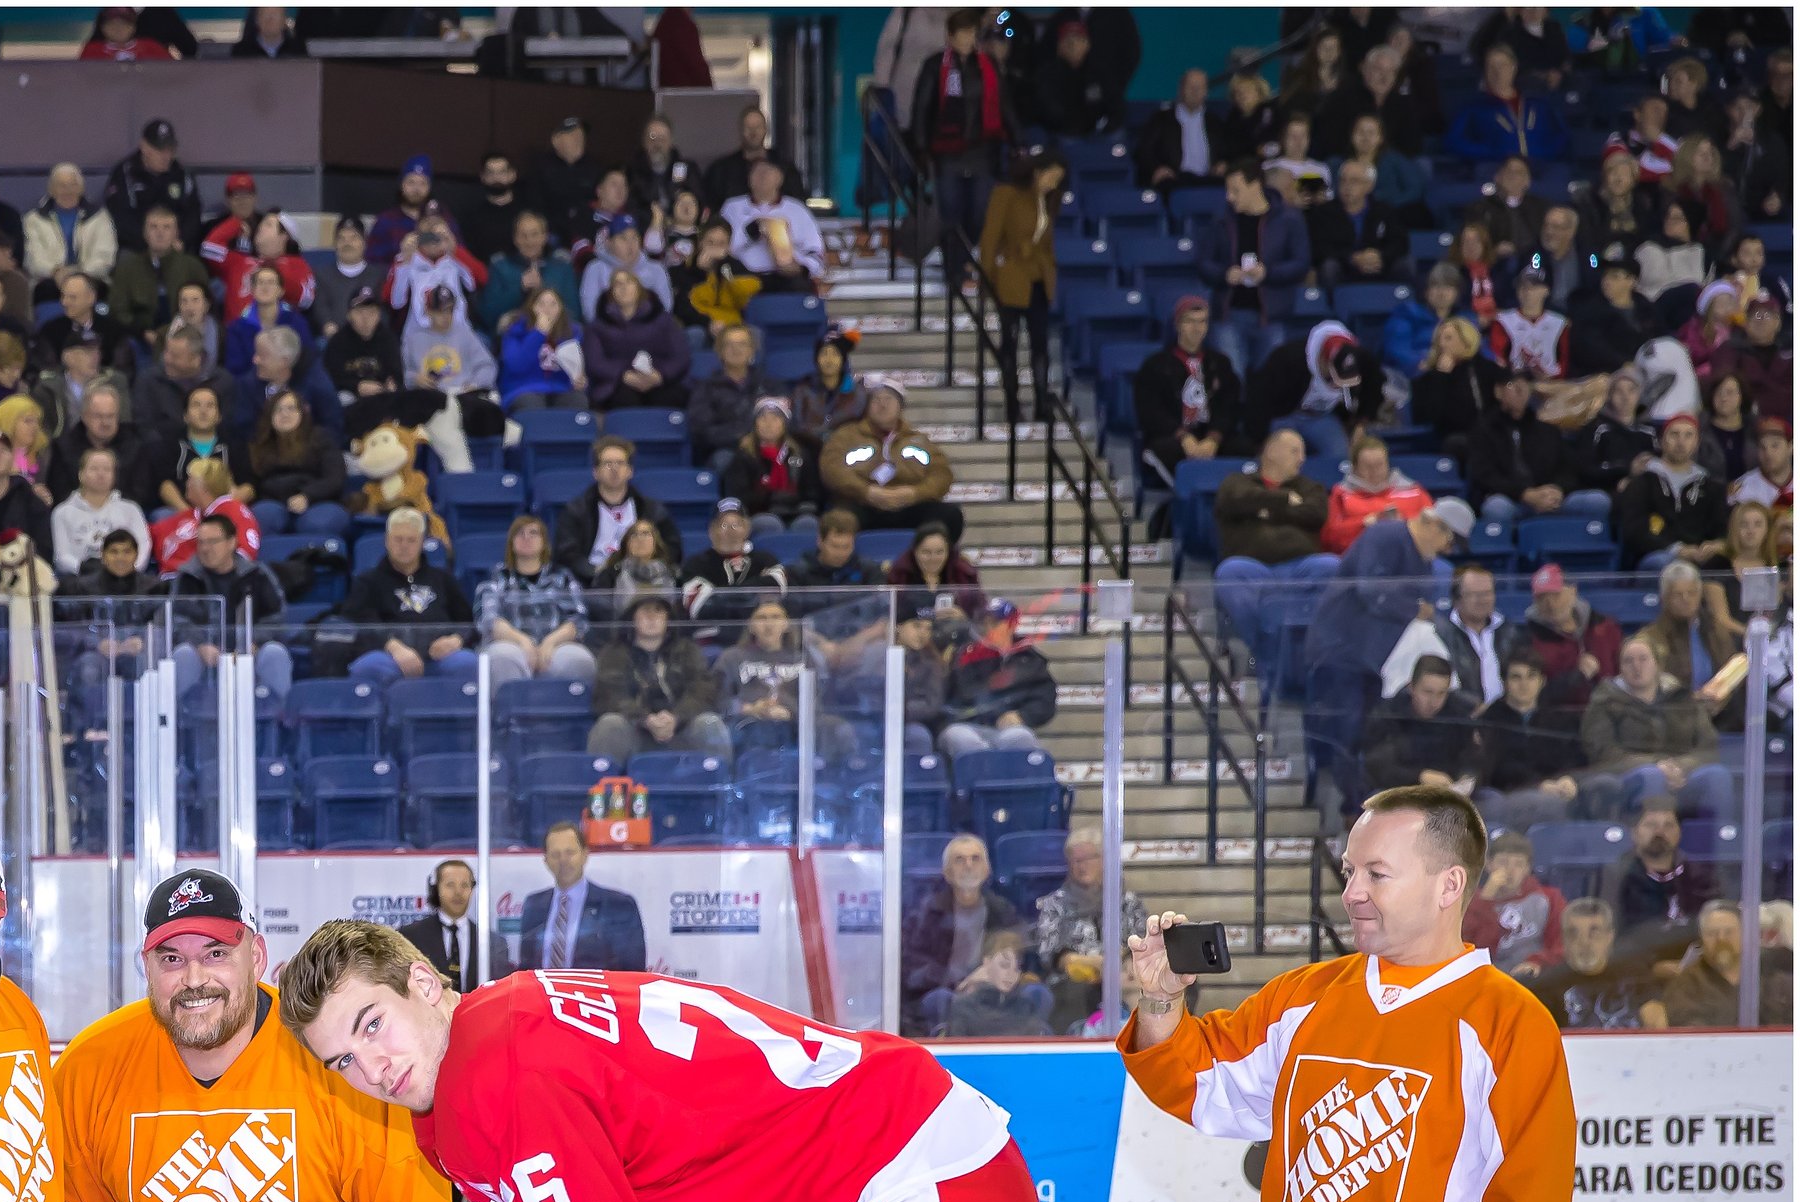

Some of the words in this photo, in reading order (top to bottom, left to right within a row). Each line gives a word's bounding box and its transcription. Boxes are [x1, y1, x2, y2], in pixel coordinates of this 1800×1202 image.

[1300, 1077, 1355, 1136] THE
[1576, 1117, 1652, 1146] OICE
[1664, 1117, 1704, 1146] OF
[1715, 1116, 1775, 1146] THE
[1574, 1165, 1633, 1193] ARA
[1646, 1163, 1784, 1193] ICEDOGS
